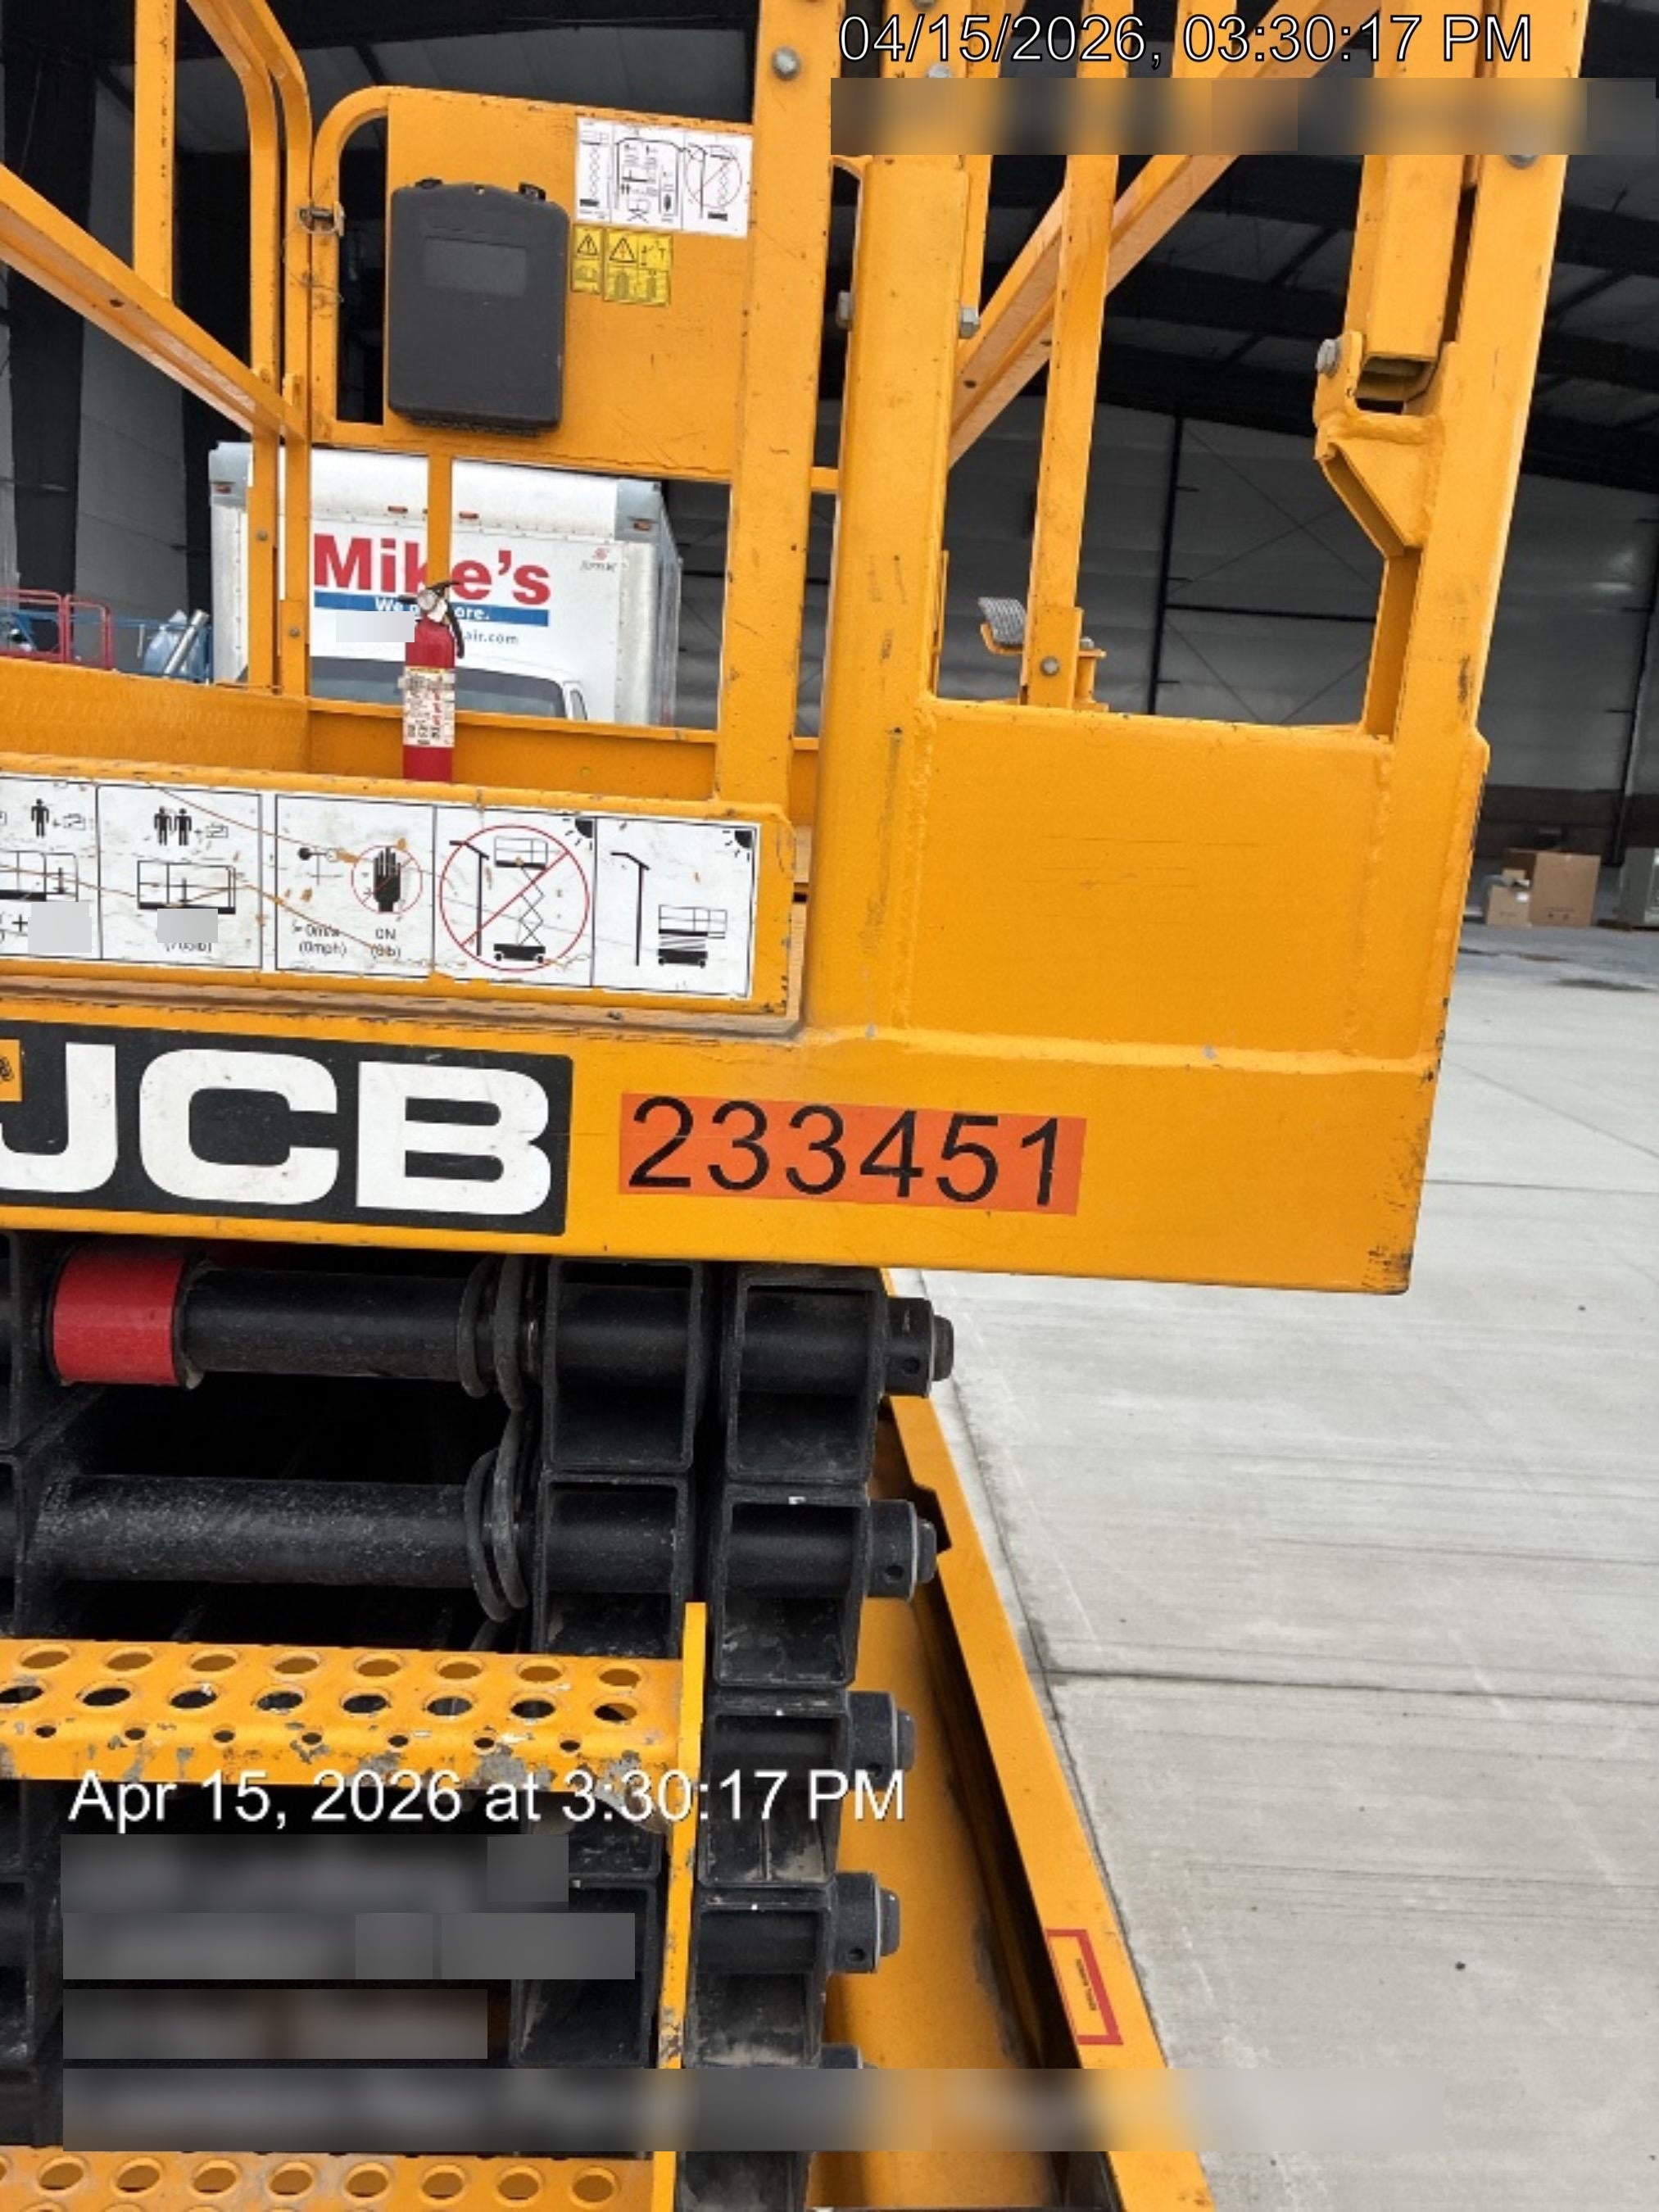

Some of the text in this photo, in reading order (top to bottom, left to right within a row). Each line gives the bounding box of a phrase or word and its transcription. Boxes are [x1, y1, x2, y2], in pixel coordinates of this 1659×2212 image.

[314, 533, 551, 605] Mike's
[0, 1040, 551, 1216] JCB
[628, 1095, 1058, 1206] 233451
